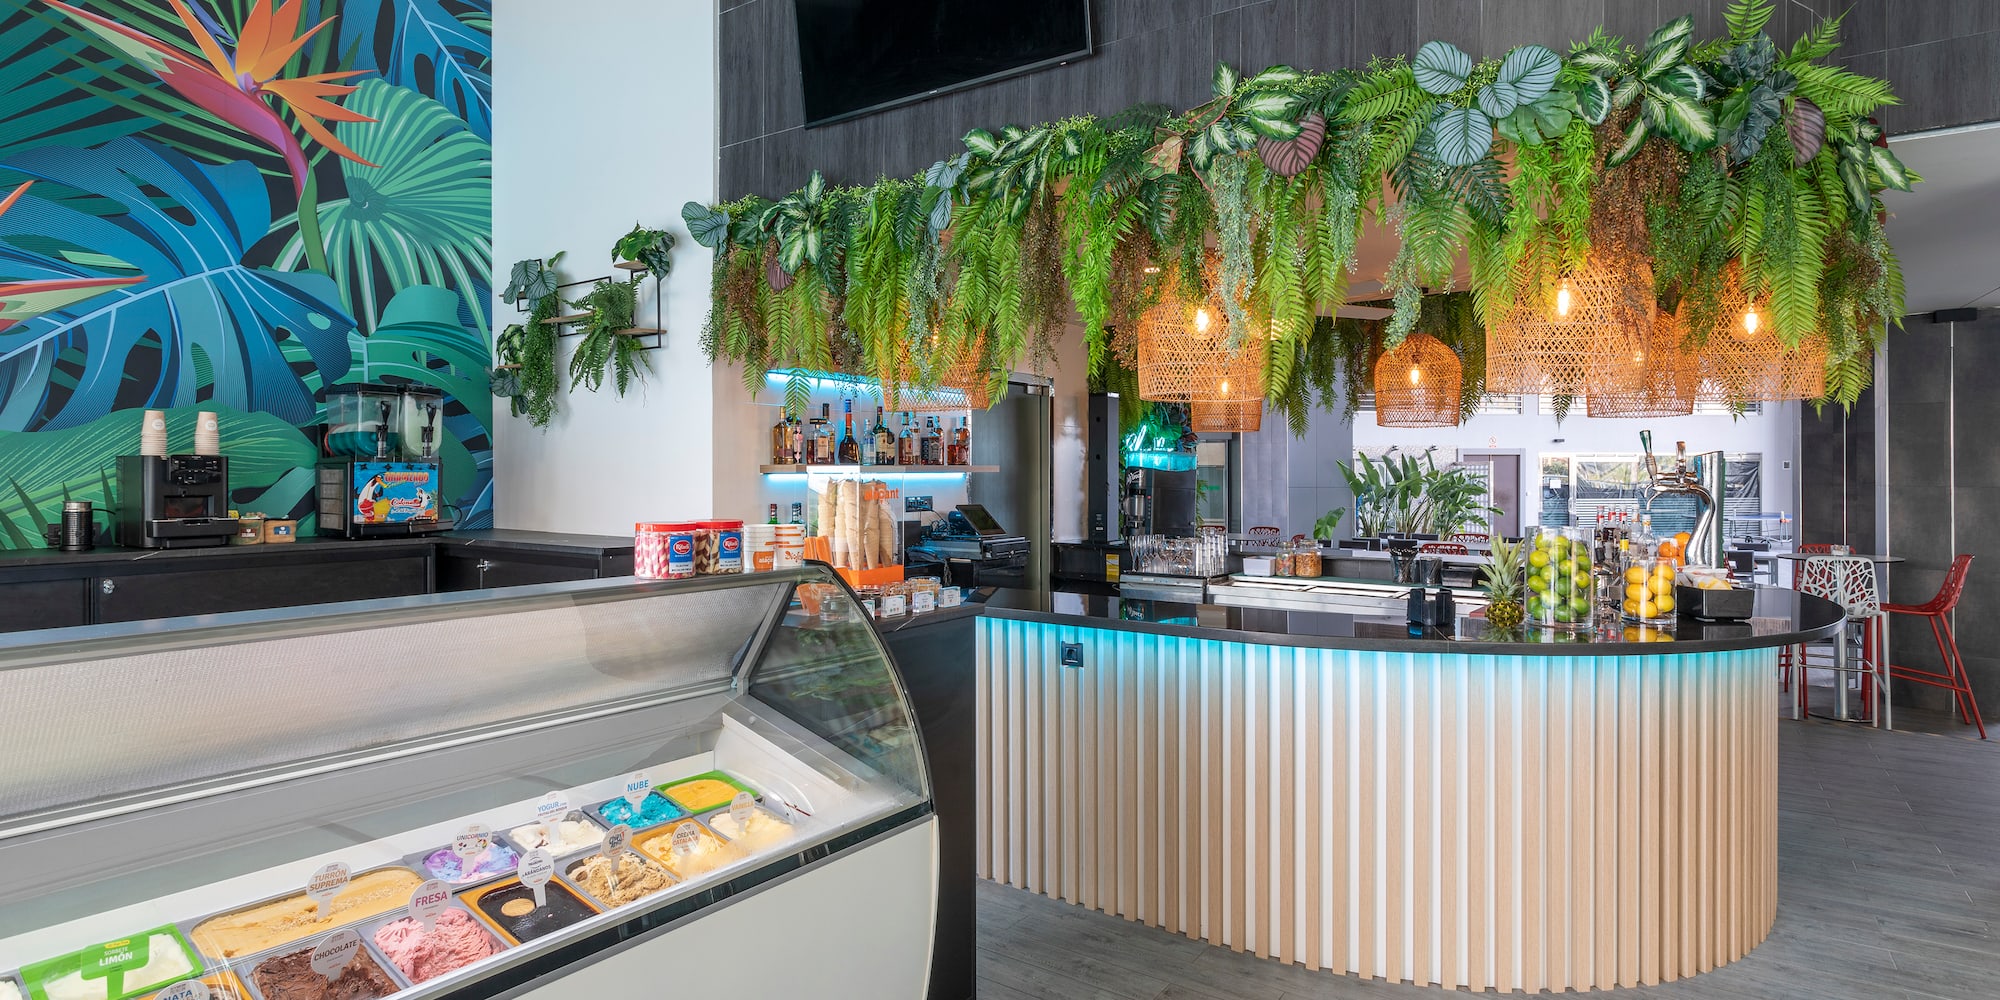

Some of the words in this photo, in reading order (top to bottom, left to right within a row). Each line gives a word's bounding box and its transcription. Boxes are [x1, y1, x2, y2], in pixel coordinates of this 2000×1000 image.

[627, 779, 649, 792] NUBE
[537, 801, 559, 812] YOGUR
[456, 832, 489, 841] UNICORNIO
[309, 876, 348, 891] SUPREMA
[415, 891, 448, 907] FRESA
[103, 946, 129, 956] SORBETE
[314, 939, 359, 961] CHOCOLATE
[99, 950, 134, 967] LIMÓN
